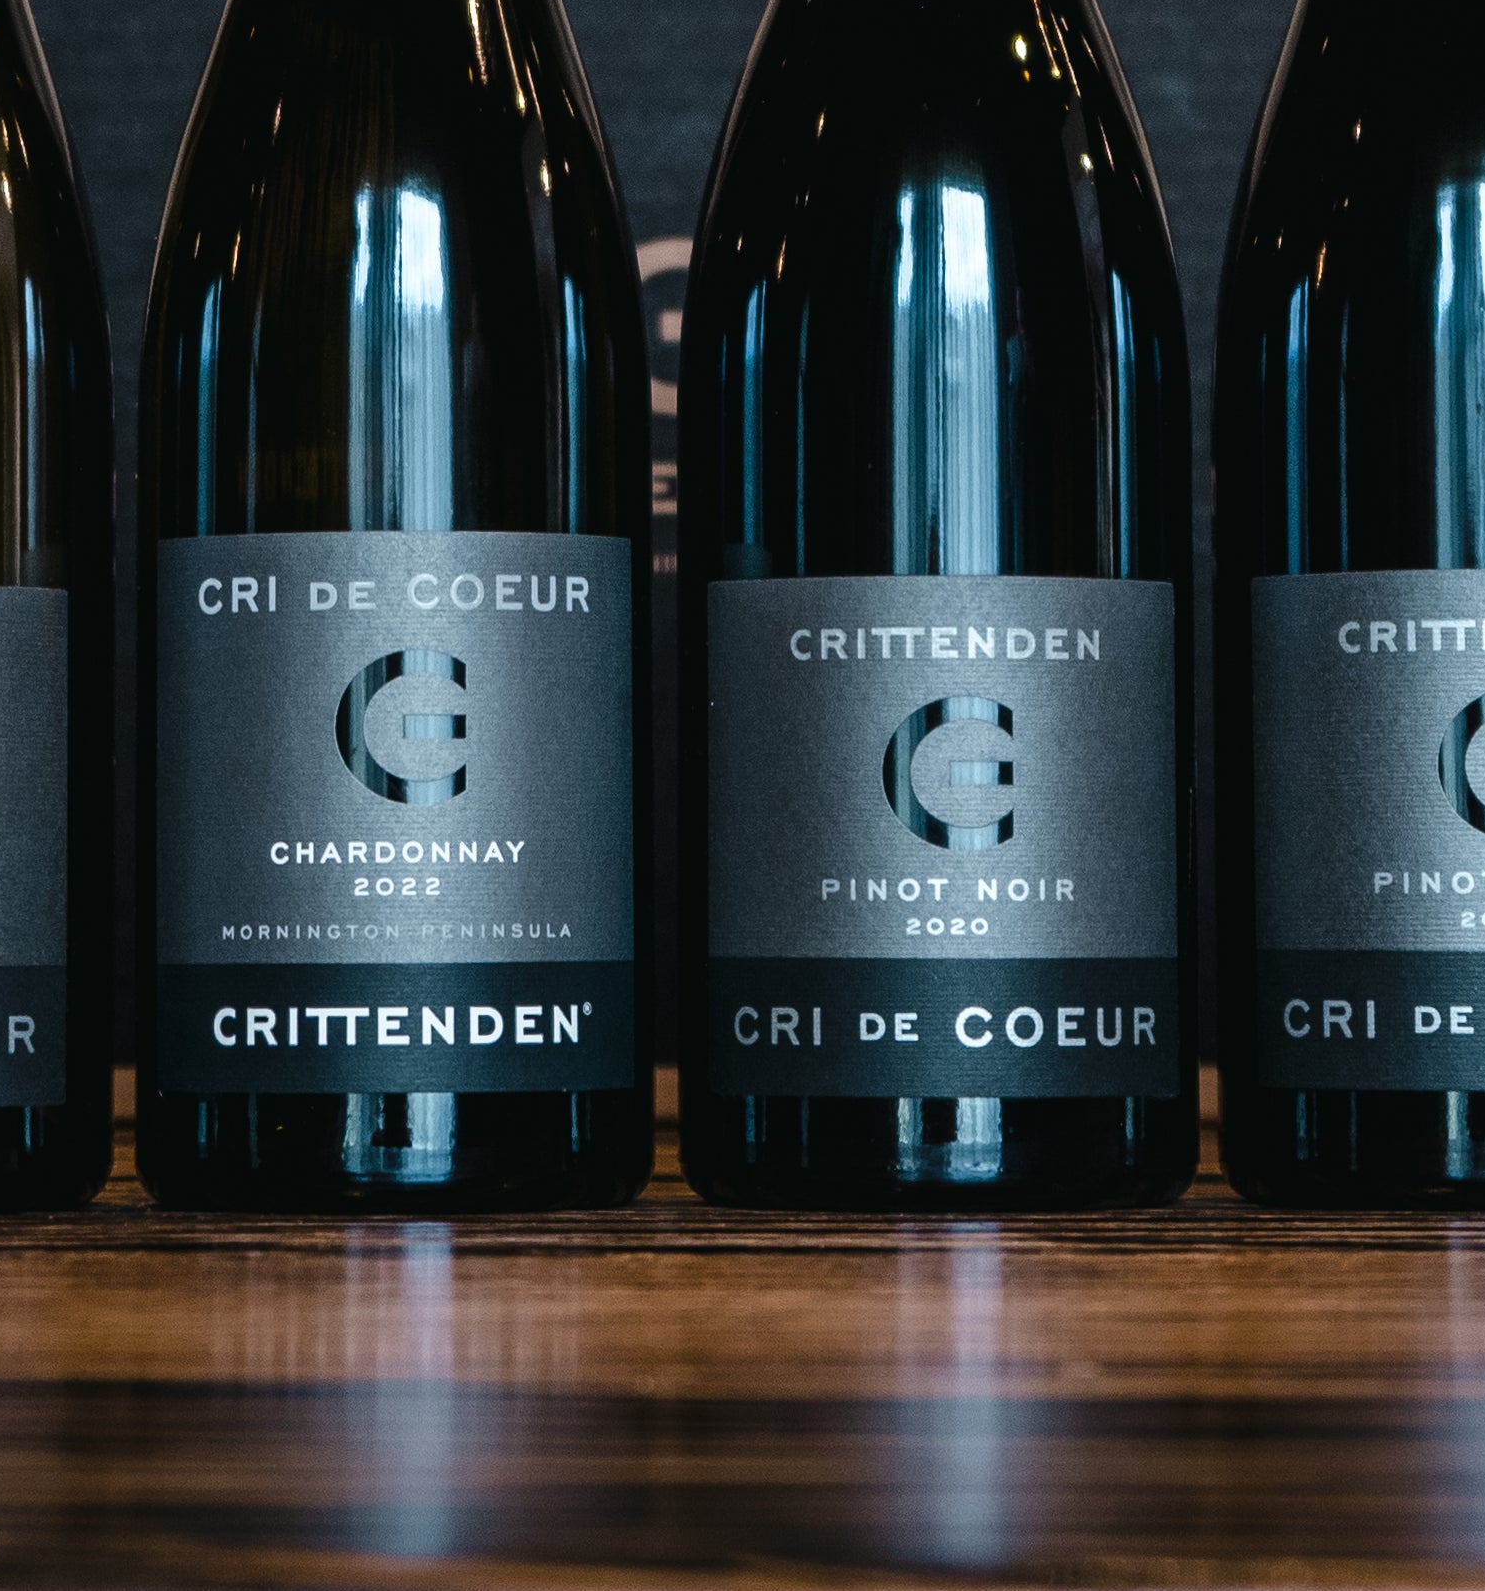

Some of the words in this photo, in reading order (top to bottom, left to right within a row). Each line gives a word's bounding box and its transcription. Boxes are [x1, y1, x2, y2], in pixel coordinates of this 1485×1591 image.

[198, 575, 277, 616] CRI
[309, 581, 376, 611] DE
[408, 573, 590, 613] COEUR
[789, 625, 1100, 662] CRITTENDEN
[269, 840, 525, 866] CHARDONNAY
[353, 876, 441, 897] 2022
[821, 877, 949, 902] PINOT
[976, 877, 1075, 902] NOIR
[221, 923, 400, 941] MORNINGTON
[421, 922, 572, 939] PENINSULA
[905, 916, 989, 936] 2020
[734, 1005, 822, 1047] CRI
[859, 1012, 920, 1042] DE
[954, 1005, 1155, 1048] COEUR
[1283, 998, 1377, 1039] CRI
[1414, 1005, 1475, 1035] DE
